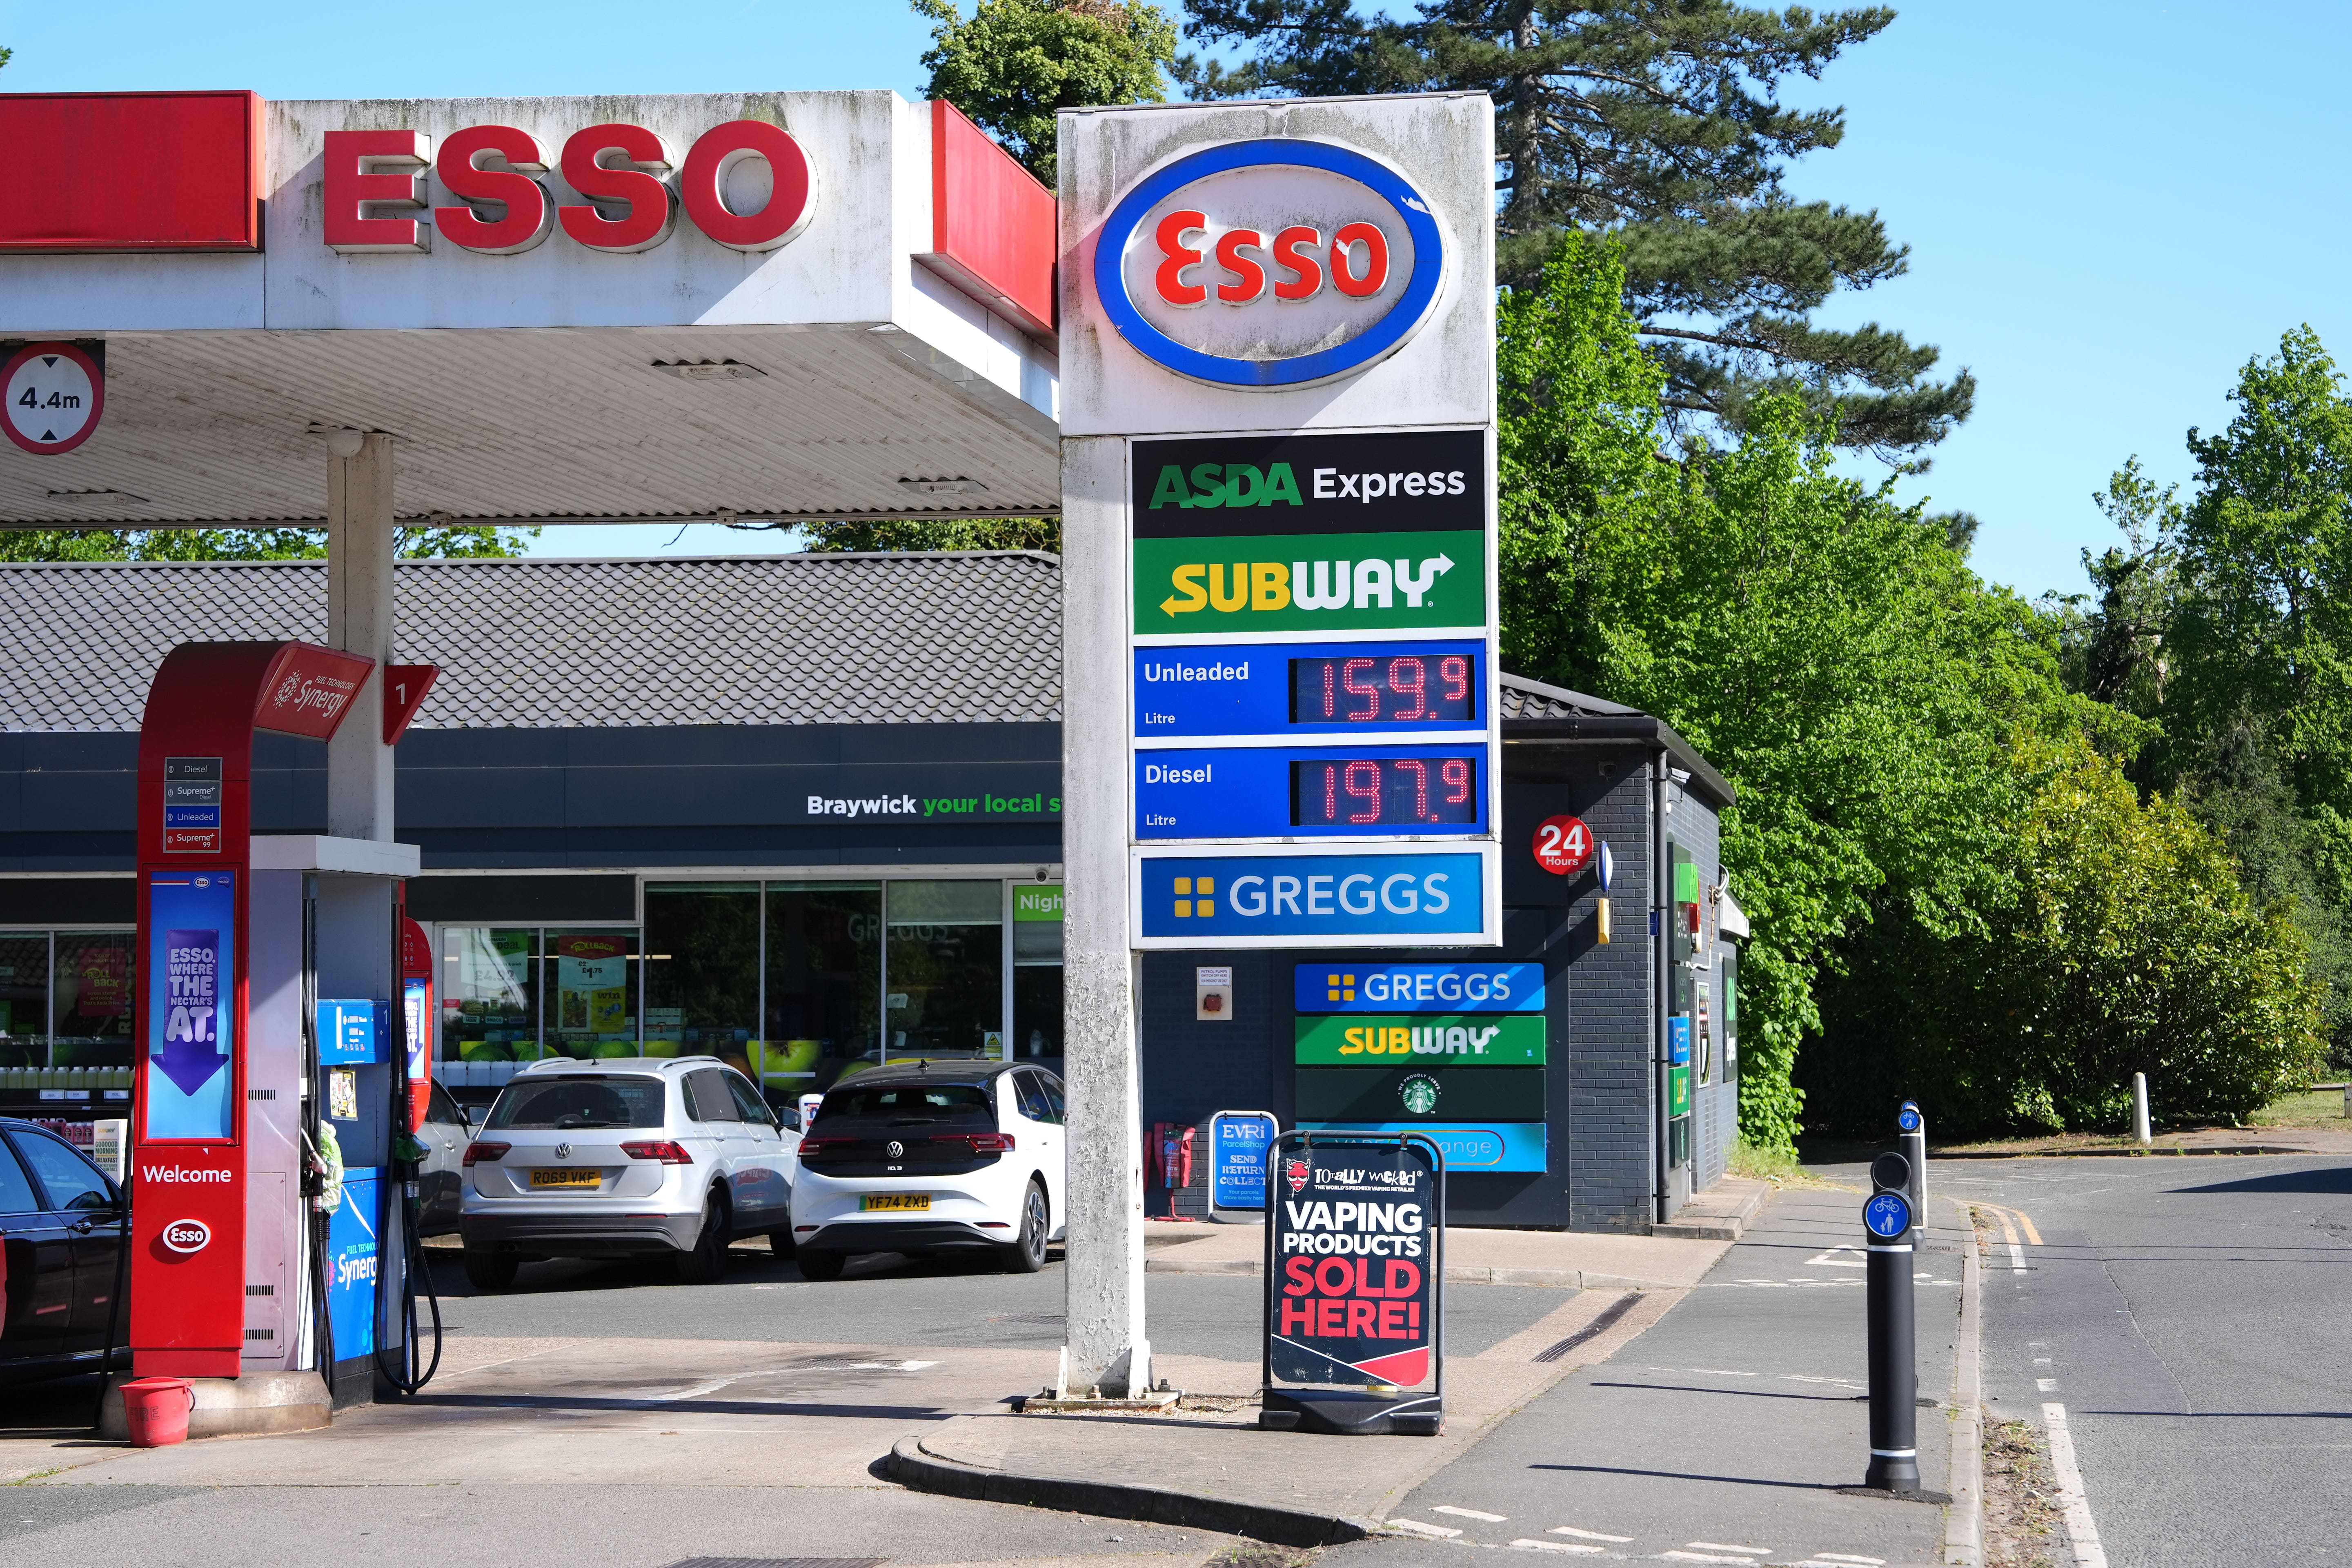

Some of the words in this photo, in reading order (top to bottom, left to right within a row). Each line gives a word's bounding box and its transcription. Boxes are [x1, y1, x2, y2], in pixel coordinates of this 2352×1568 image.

[324, 120, 813, 251] ESSO
[19, 386, 80, 410] 4.4m
[1148, 462, 1304, 509] ASDA
[1313, 468, 1466, 504] Express
[1159, 552, 1455, 618] SUBWAY
[315, 675, 327, 685] FUEL
[326, 678, 356, 690] TECHNOLOGY
[1145, 662, 1249, 683] Unleaded
[395, 683, 405, 705] 1
[1324, 656, 1466, 721] 159.9
[294, 680, 348, 718] Synergy
[1145, 712, 1175, 725] Litre
[1146, 764, 1212, 784] Diesel
[1326, 759, 1468, 823] 197.9
[807, 794, 917, 817] Braywick
[923, 796, 978, 817] your
[985, 793, 1041, 812] local
[1146, 814, 1176, 826] Litre
[1540, 825, 1586, 856] 24
[1546, 856, 1578, 866] Hours
[1020, 894, 1063, 912] Nigh
[1229, 873, 1450, 916] GREGGS
[170, 947, 216, 963] ESSO.
[170, 963, 213, 975] WHERE
[582, 967, 603, 978] £1.75
[169, 975, 213, 996] THE
[596, 990, 621, 999] win
[1364, 973, 1510, 1001] GREGGS
[171, 997, 213, 1005] NECTAR'S
[166, 1006, 215, 1042] AT.
[384, 1009, 387, 1025] 1
[1338, 1025, 1501, 1056] SUBWAY
[1398, 1083, 1404, 1091] WE
[1403, 1073, 1427, 1083] PROUDLY
[1428, 1076, 1441, 1090] SERVE
[1222, 1140, 1265, 1150] ParcelShop
[1230, 1155, 1257, 1163] SEND
[142, 1164, 232, 1183] Welcome
[534, 1172, 567, 1183] RO69
[571, 1172, 595, 1183] VKF
[1222, 1165, 1265, 1174] RETURN
[868, 1197, 900, 1208] YF74
[904, 1196, 929, 1208] ZXD
[1285, 1201, 1422, 1234] VAPING
[347, 1245, 358, 1255] FUEL
[1283, 1233, 1422, 1257] PRODUCTS
[1283, 1256, 1421, 1298] SOLD
[1281, 1298, 1420, 1340] HERE!
[128, 1406, 160, 1421] FIRE
